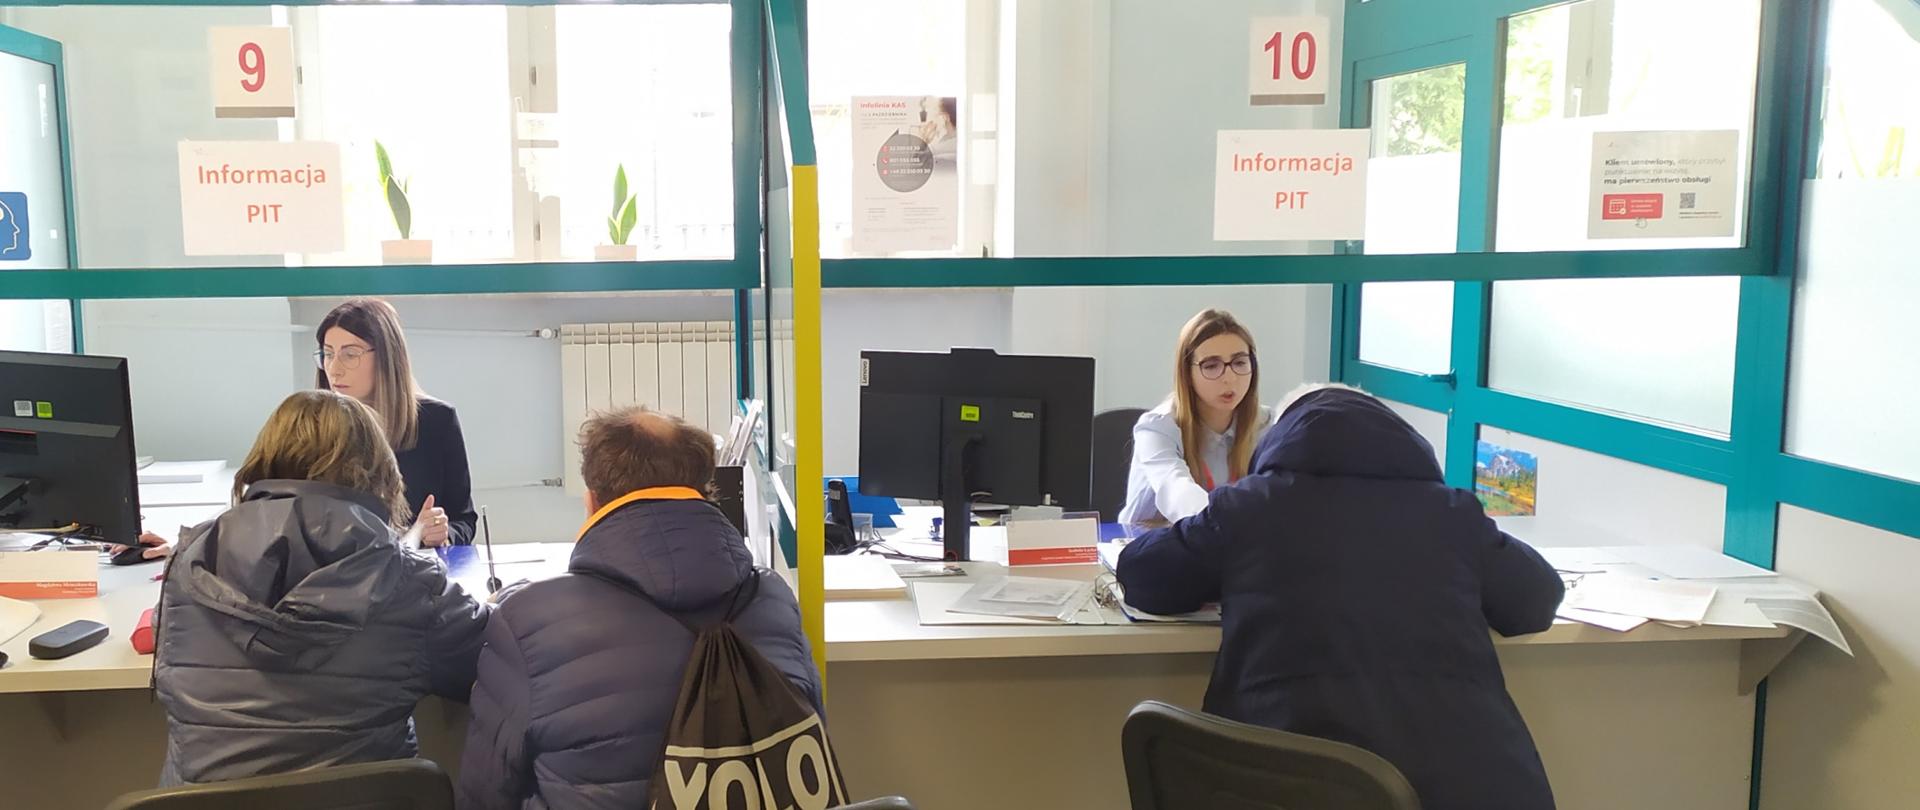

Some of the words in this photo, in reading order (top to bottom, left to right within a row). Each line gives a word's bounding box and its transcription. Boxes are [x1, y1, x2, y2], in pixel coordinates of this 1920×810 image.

[238, 42, 266, 93] 9
[1264, 31, 1317, 81] 10
[198, 164, 327, 188] Informacja
[1233, 152, 1353, 176] Informacja
[1275, 191, 1309, 210] PIT
[247, 204, 283, 223] PIT
[664, 734, 830, 810] YOLO
